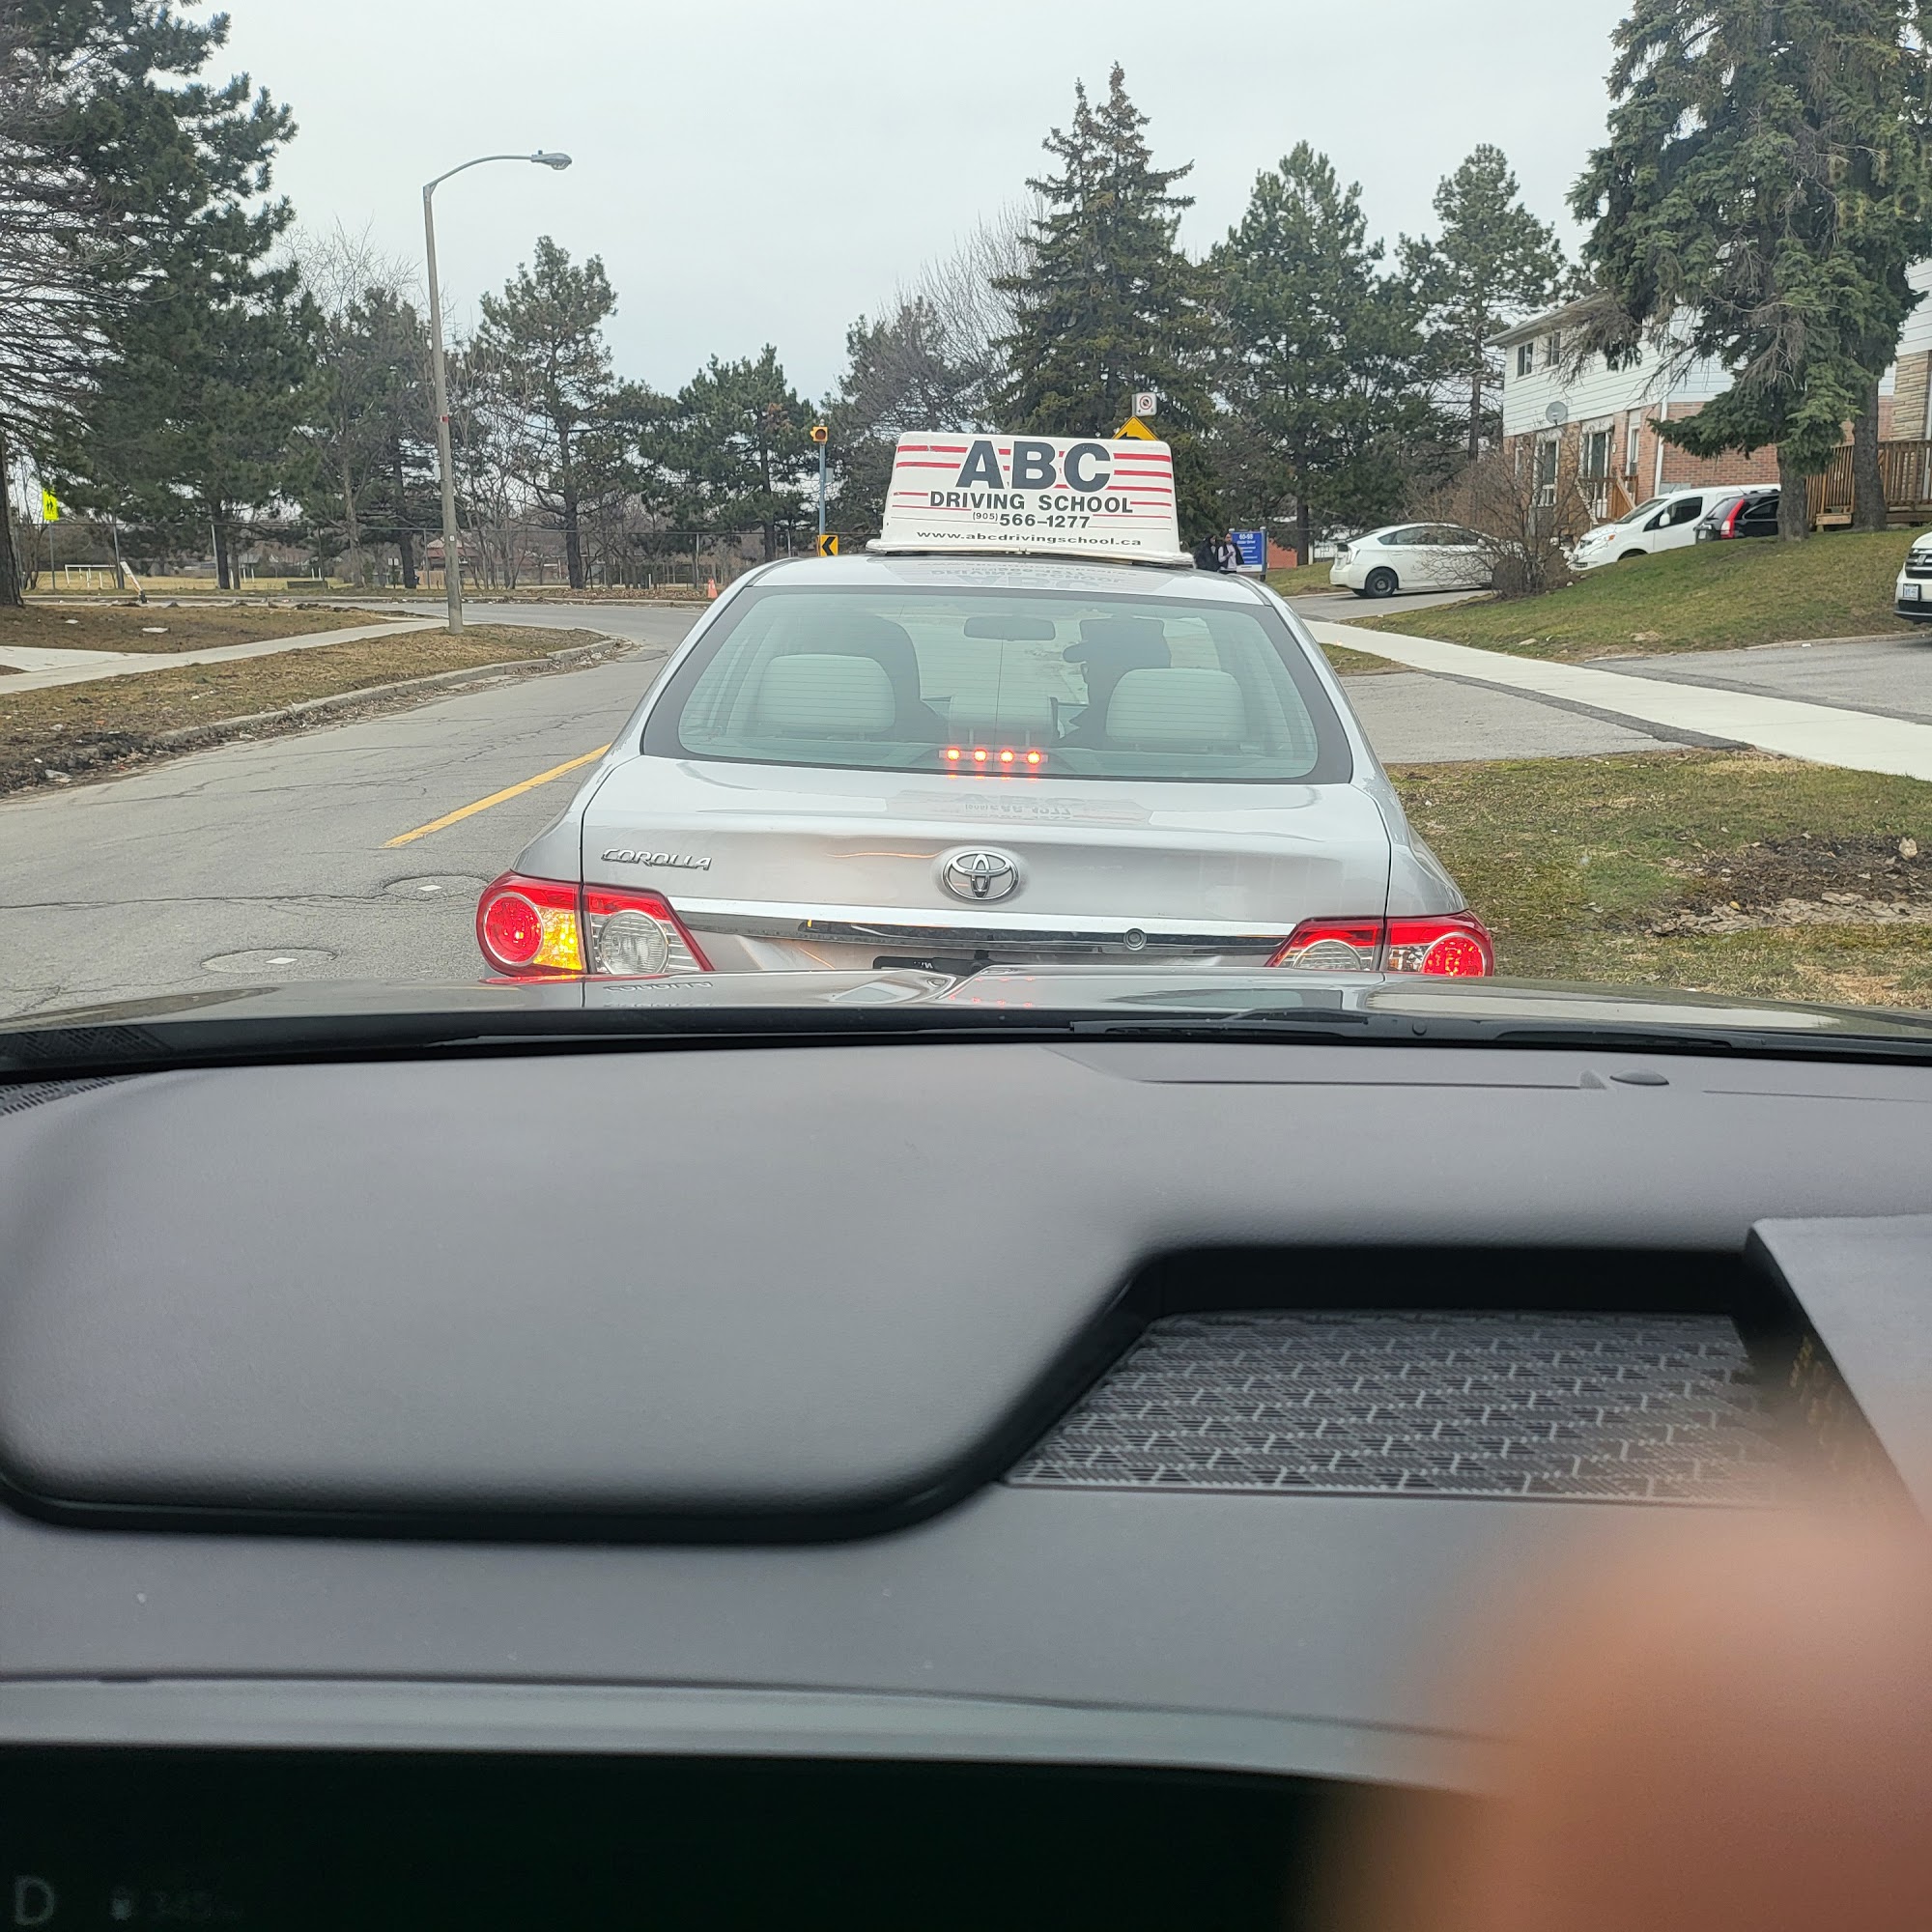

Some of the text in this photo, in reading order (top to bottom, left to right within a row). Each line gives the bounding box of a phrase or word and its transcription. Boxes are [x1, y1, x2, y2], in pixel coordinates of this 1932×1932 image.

[955, 440, 1111, 493] ABC
[929, 490, 1133, 514] DRIVING SCHOOL
[999, 513, 1091, 529] 566-1277
[917, 530, 1142, 547] www.abcdrivingschool.ca
[600, 848, 713, 871] COROLLA
